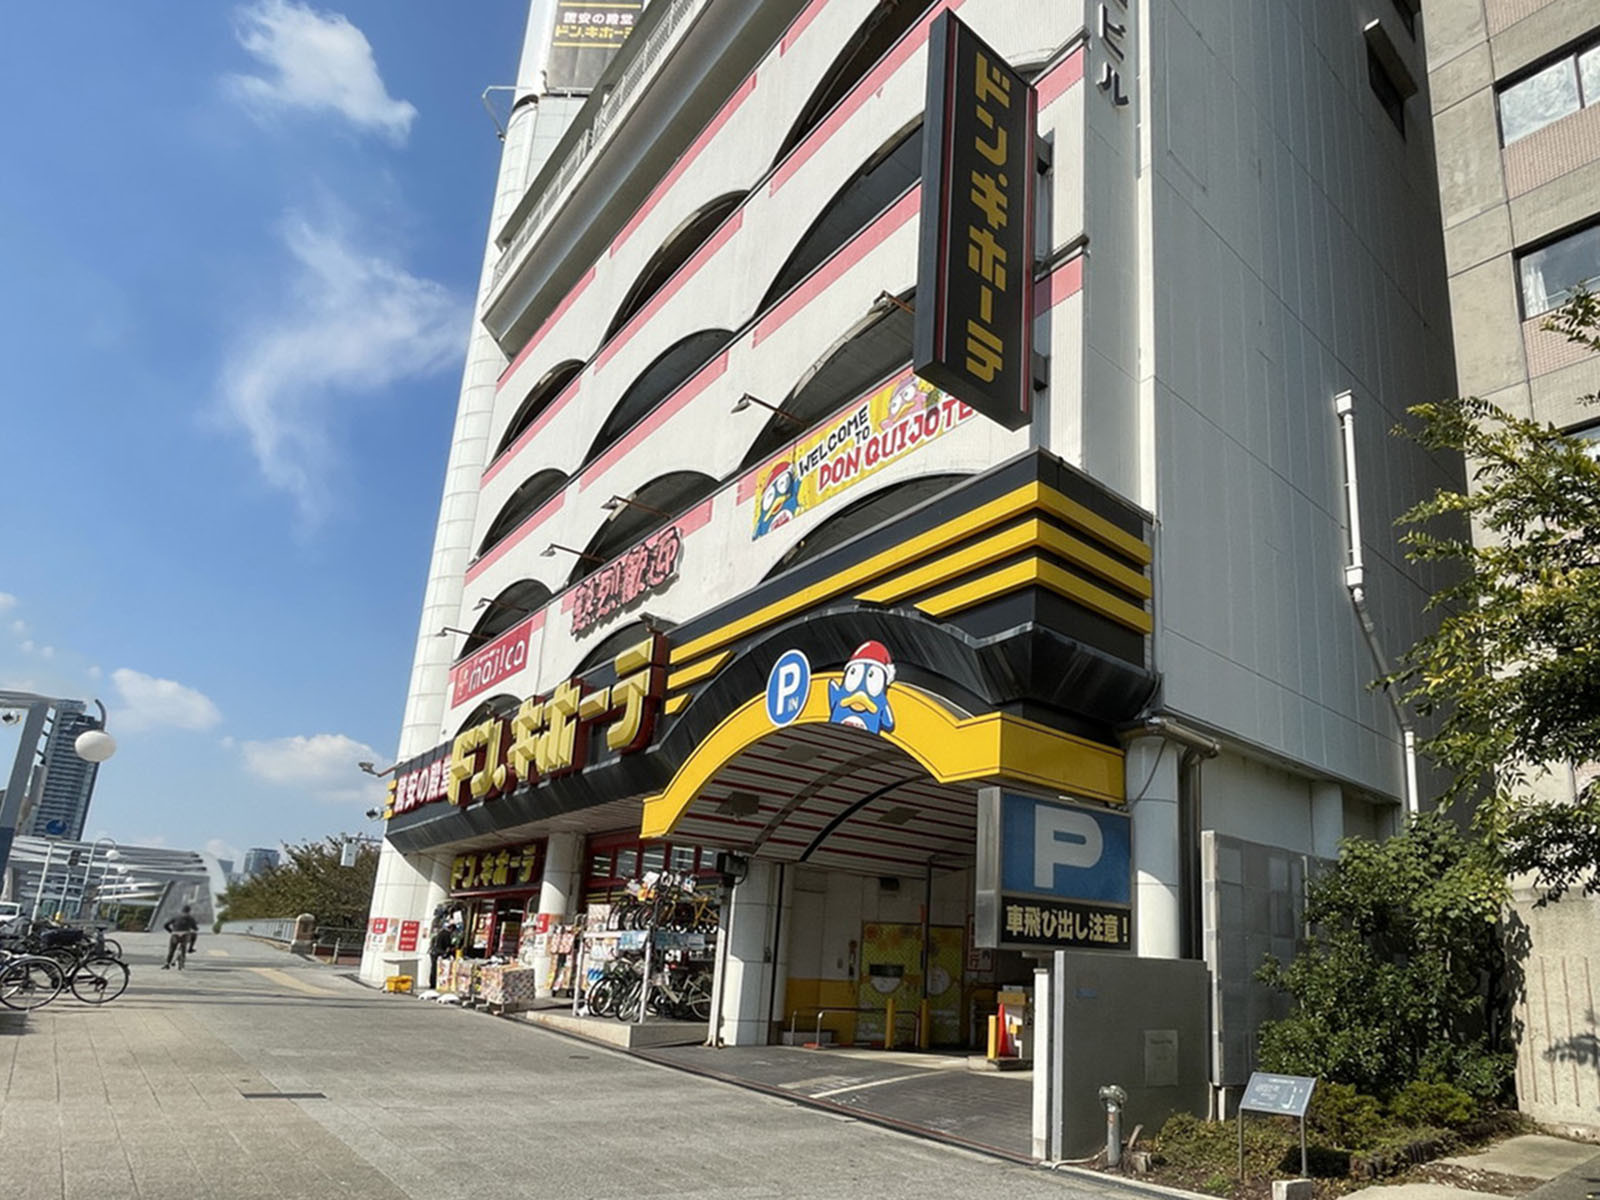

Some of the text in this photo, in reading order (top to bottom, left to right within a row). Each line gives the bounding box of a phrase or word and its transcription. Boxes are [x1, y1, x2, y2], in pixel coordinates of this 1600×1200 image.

[798, 405, 870, 477] WELCOME TO
[818, 446, 862, 492] DON
[775, 661, 801, 716] P
[1033, 803, 1104, 889] P
[1006, 904, 1129, 943] 車飛び出し注意!
